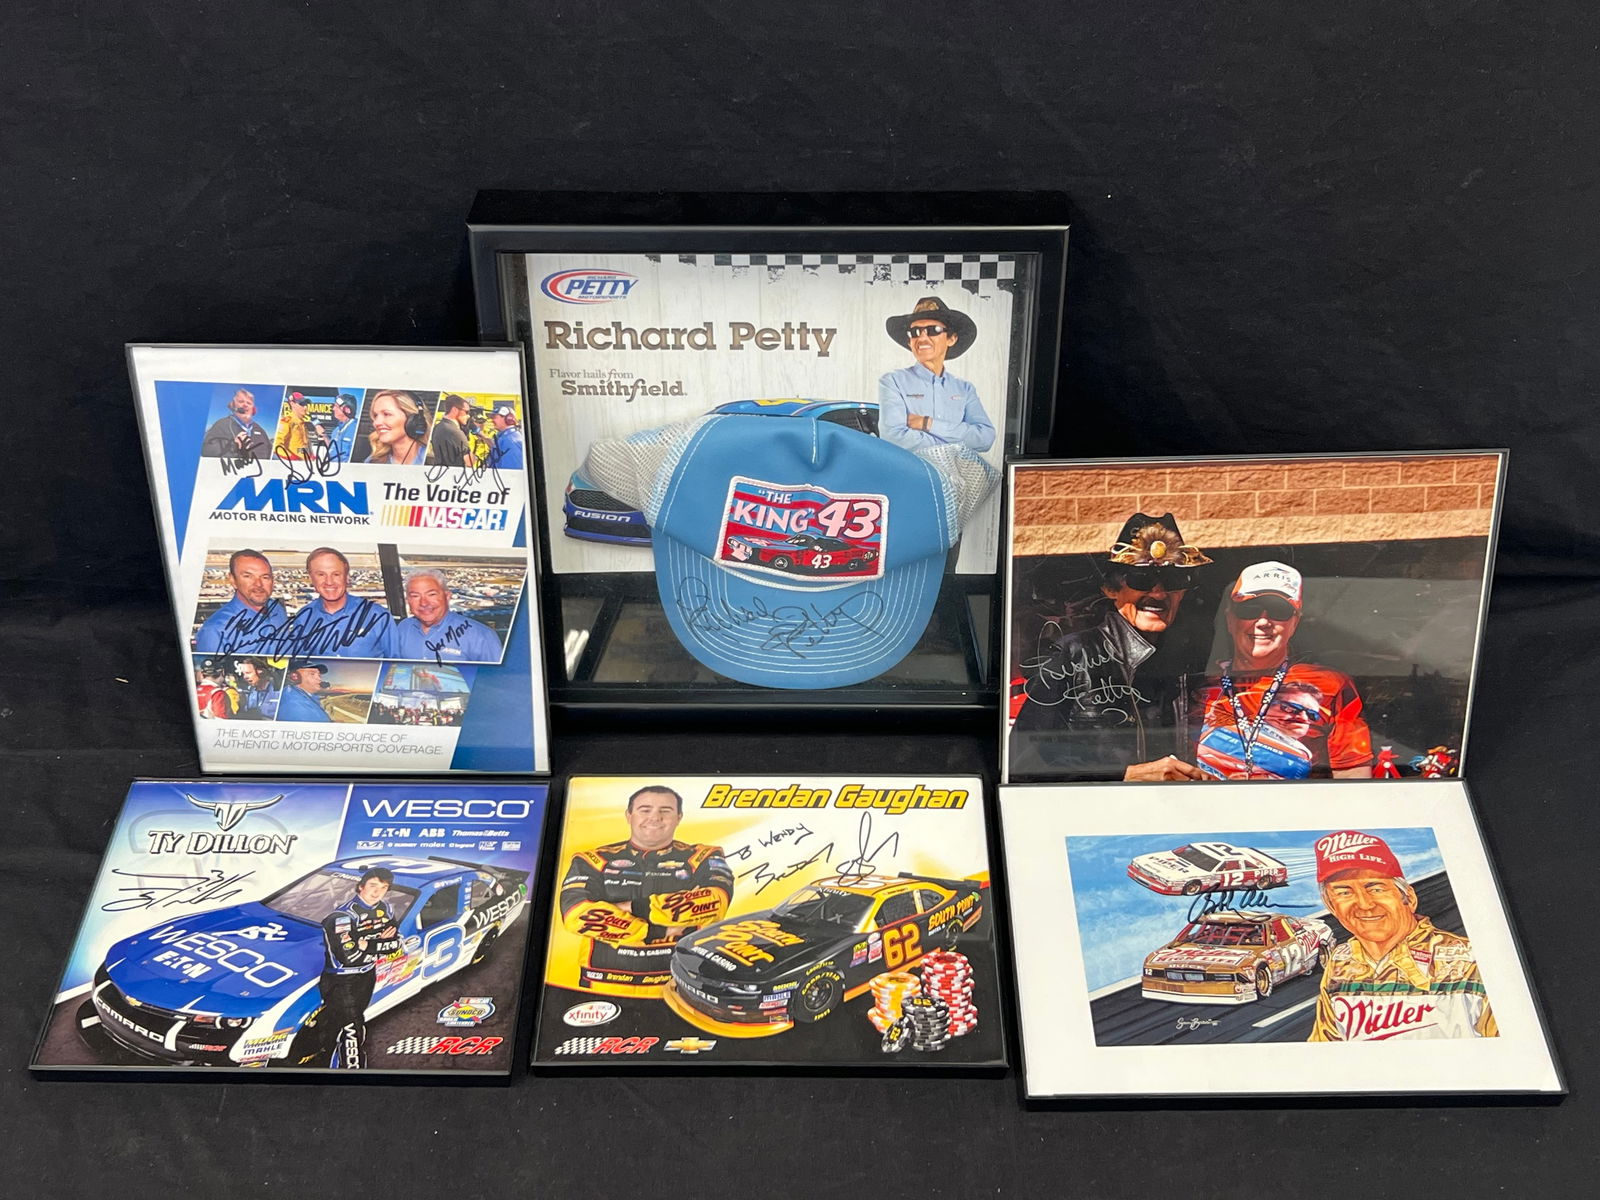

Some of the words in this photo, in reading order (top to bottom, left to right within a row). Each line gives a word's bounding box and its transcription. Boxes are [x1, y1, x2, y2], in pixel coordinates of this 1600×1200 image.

[565, 279, 639, 295] PETTY
[544, 320, 717, 351] Richard
[728, 321, 837, 357] Petty
[549, 368, 582, 379] Flavor
[583, 369, 607, 379] hails
[607, 368, 634, 382] from
[215, 477, 370, 516] MRN
[383, 482, 420, 501] The
[426, 484, 481, 504] Voice
[487, 488, 511, 505] of
[209, 511, 257, 522] MOTOR
[260, 513, 307, 523] RACING
[309, 514, 371, 526] NETWORK
[420, 505, 505, 530] NASCAR
[574, 510, 631, 522] FUSION
[817, 501, 882, 539] 43
[811, 553, 832, 569] 43
[216, 728, 247, 738] THE
[249, 728, 278, 738] MOST
[280, 729, 335, 741] TRUSTED
[336, 732, 389, 743] SOURCE
[390, 733, 408, 743] OF
[213, 739, 280, 750] AUTHENTIC
[282, 741, 374, 753] MOTORSPORTS
[376, 744, 444, 755] COVERAGE.
[700, 783, 833, 808] Brendan
[834, 784, 969, 815] Gaughan
[362, 799, 530, 819] WESCO
[418, 827, 446, 838] ABB
[148, 830, 185, 854] TY
[186, 832, 294, 855] DILLON
[1200, 843, 1242, 857] 12
[1317, 832, 1382, 860] Miller
[1148, 856, 1190, 874] PIPER
[1329, 853, 1356, 863] HIGH
[1222, 872, 1245, 887] 12
[1254, 868, 1280, 878] PIPER
[473, 889, 521, 929] WESCO
[421, 922, 467, 980] 3
[646, 948, 672, 957] CASINO
[882, 922, 923, 969] 62
[149, 925, 295, 988] WESCO
[711, 954, 737, 971] CASINO
[1281, 943, 1302, 977] 12
[606, 973, 634, 982] Brendan
[642, 975, 672, 984] Gaughan
[1145, 968, 1153, 976] 12
[96, 998, 165, 1043] CAMARO
[569, 1010, 608, 1021] xfinity
[1333, 997, 1437, 1042] Miller
[243, 1043, 284, 1055] MAHLE
[427, 1036, 503, 1055] RCR
[592, 1036, 660, 1054] RCR
